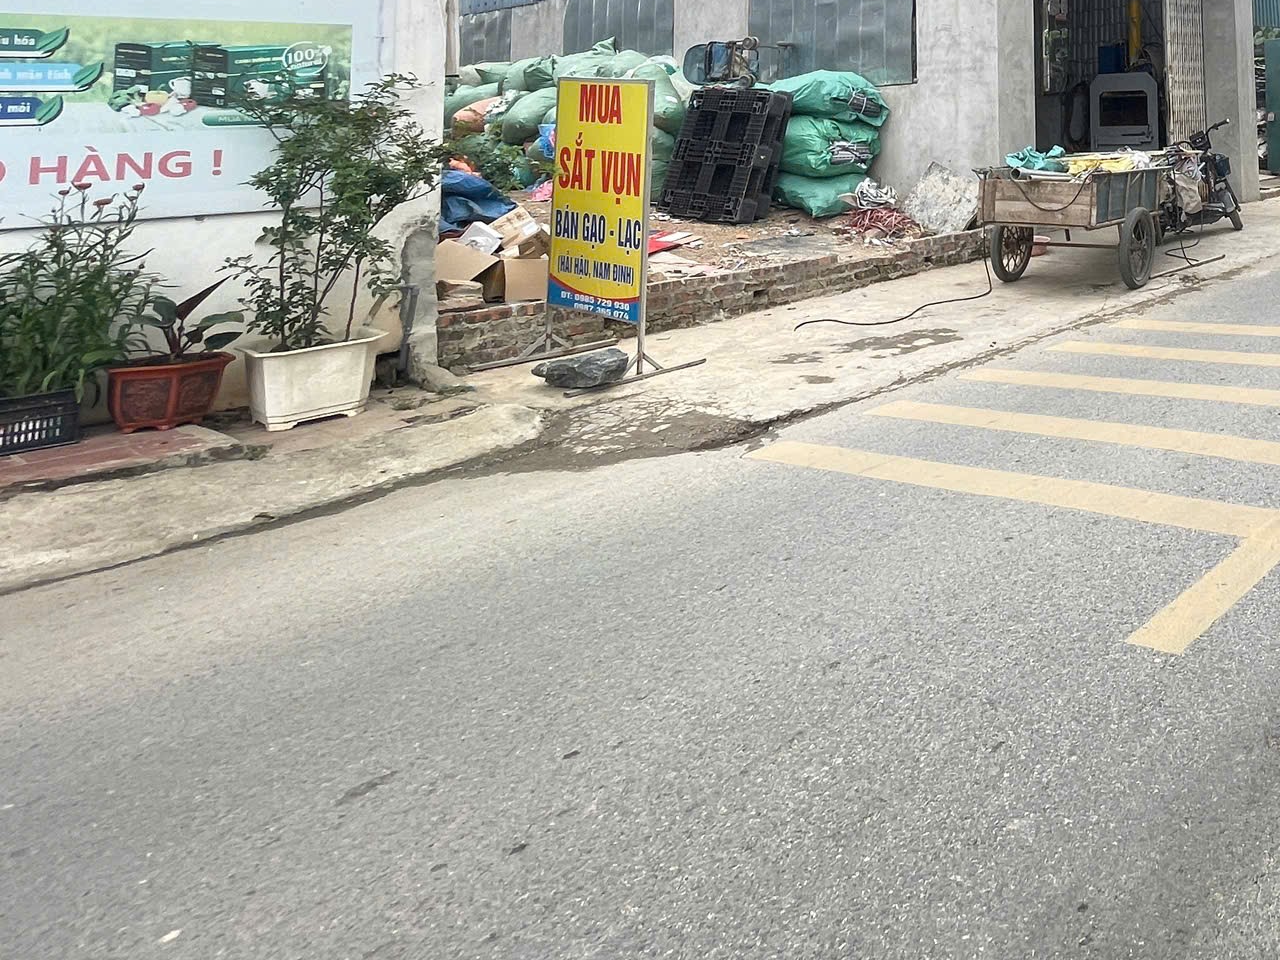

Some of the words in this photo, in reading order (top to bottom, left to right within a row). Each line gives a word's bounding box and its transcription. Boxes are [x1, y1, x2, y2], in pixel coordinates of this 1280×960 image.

[579, 84, 622, 124] MUA
[29, 145, 193, 185] HÀNG
[558, 132, 596, 191] SẮT
[601, 150, 641, 205] VỤN
[555, 205, 579, 240] BÁN
[583, 213, 606, 249] GẠO
[618, 218, 641, 255] LẠC
[593, 260, 611, 280] NAM
